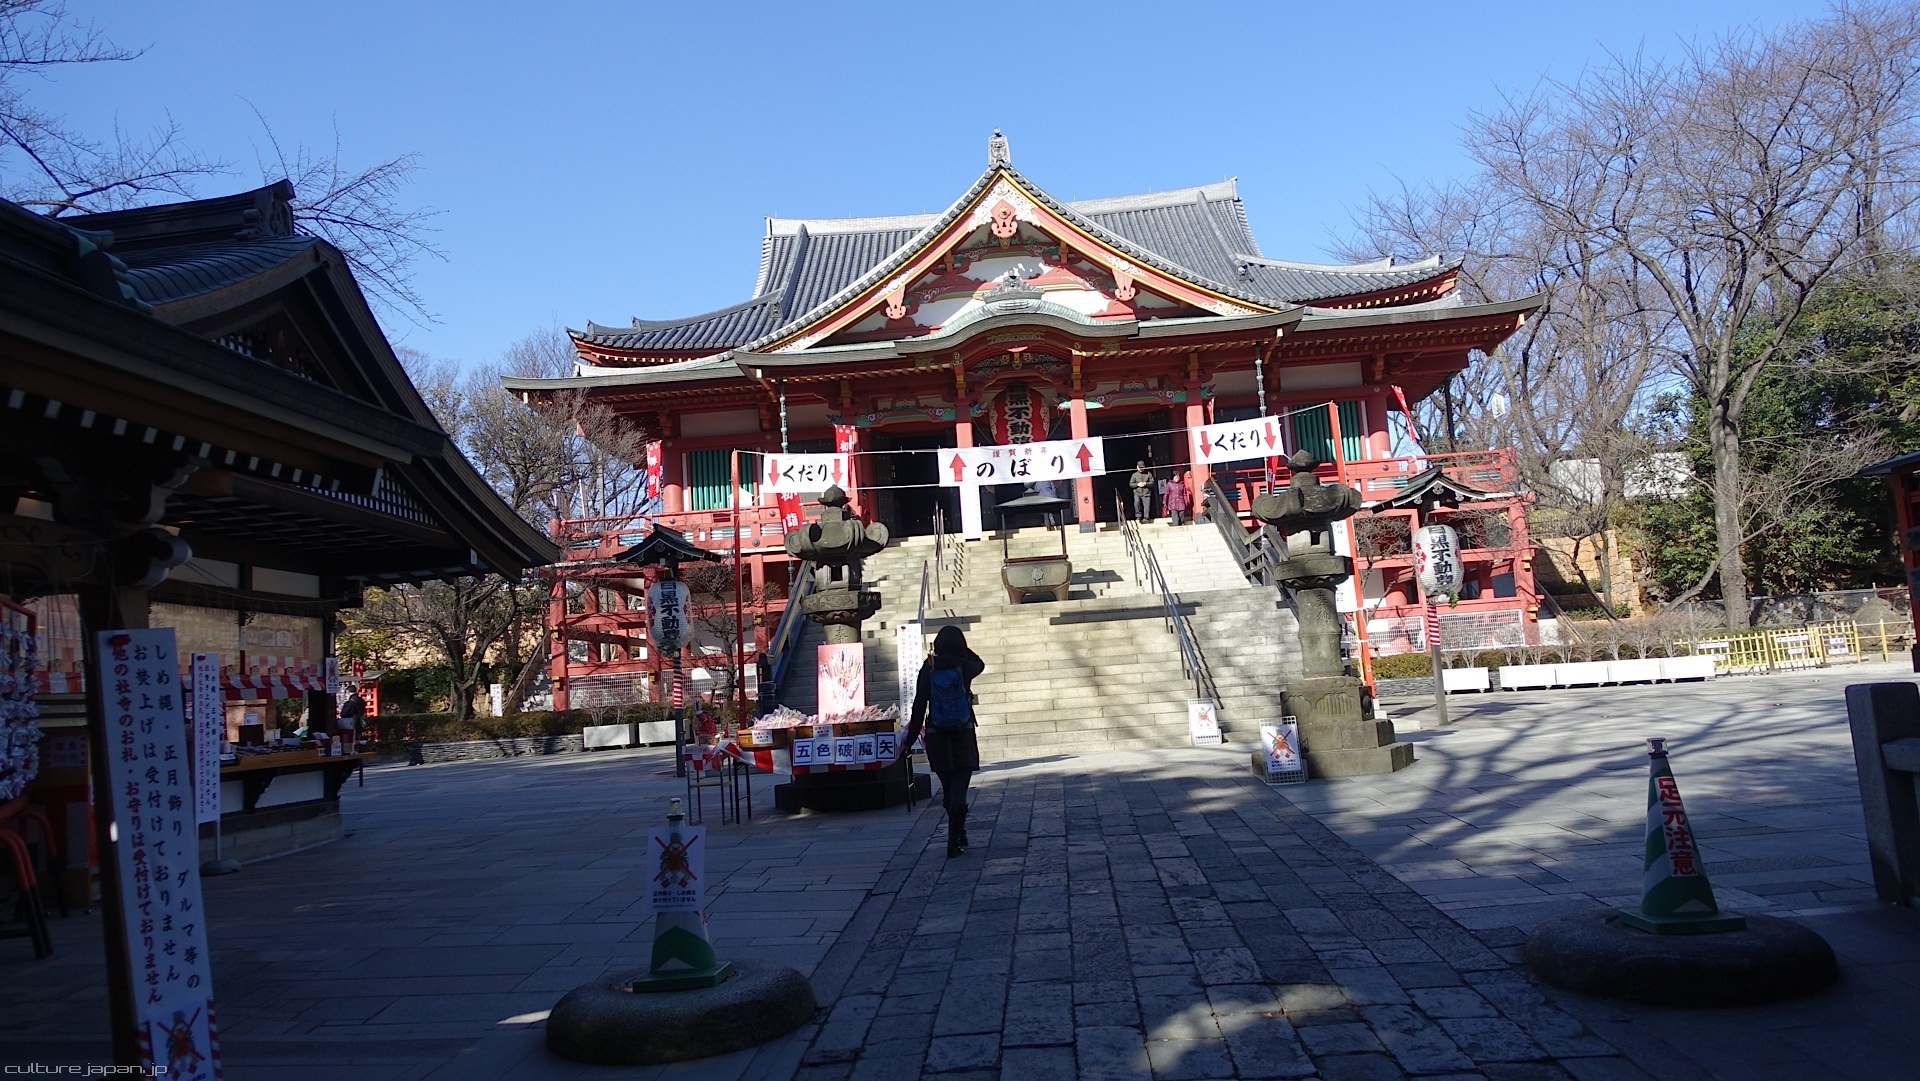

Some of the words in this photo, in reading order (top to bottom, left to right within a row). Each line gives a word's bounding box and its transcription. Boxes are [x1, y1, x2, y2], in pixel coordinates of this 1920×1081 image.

[992, 446, 1049, 458] 謹賀新年
[1214, 429, 1261, 452] くだり
[782, 464, 828, 482] くだり
[976, 455, 1064, 478] のぼり
[796, 739, 895, 758] 五色破魔矢
[134, 645, 181, 982] お焚上げは受付けておりません
[155, 645, 200, 989] しめ縄・正月飾り・ダルマ等の
[1658, 777, 1697, 875] 足元注意
